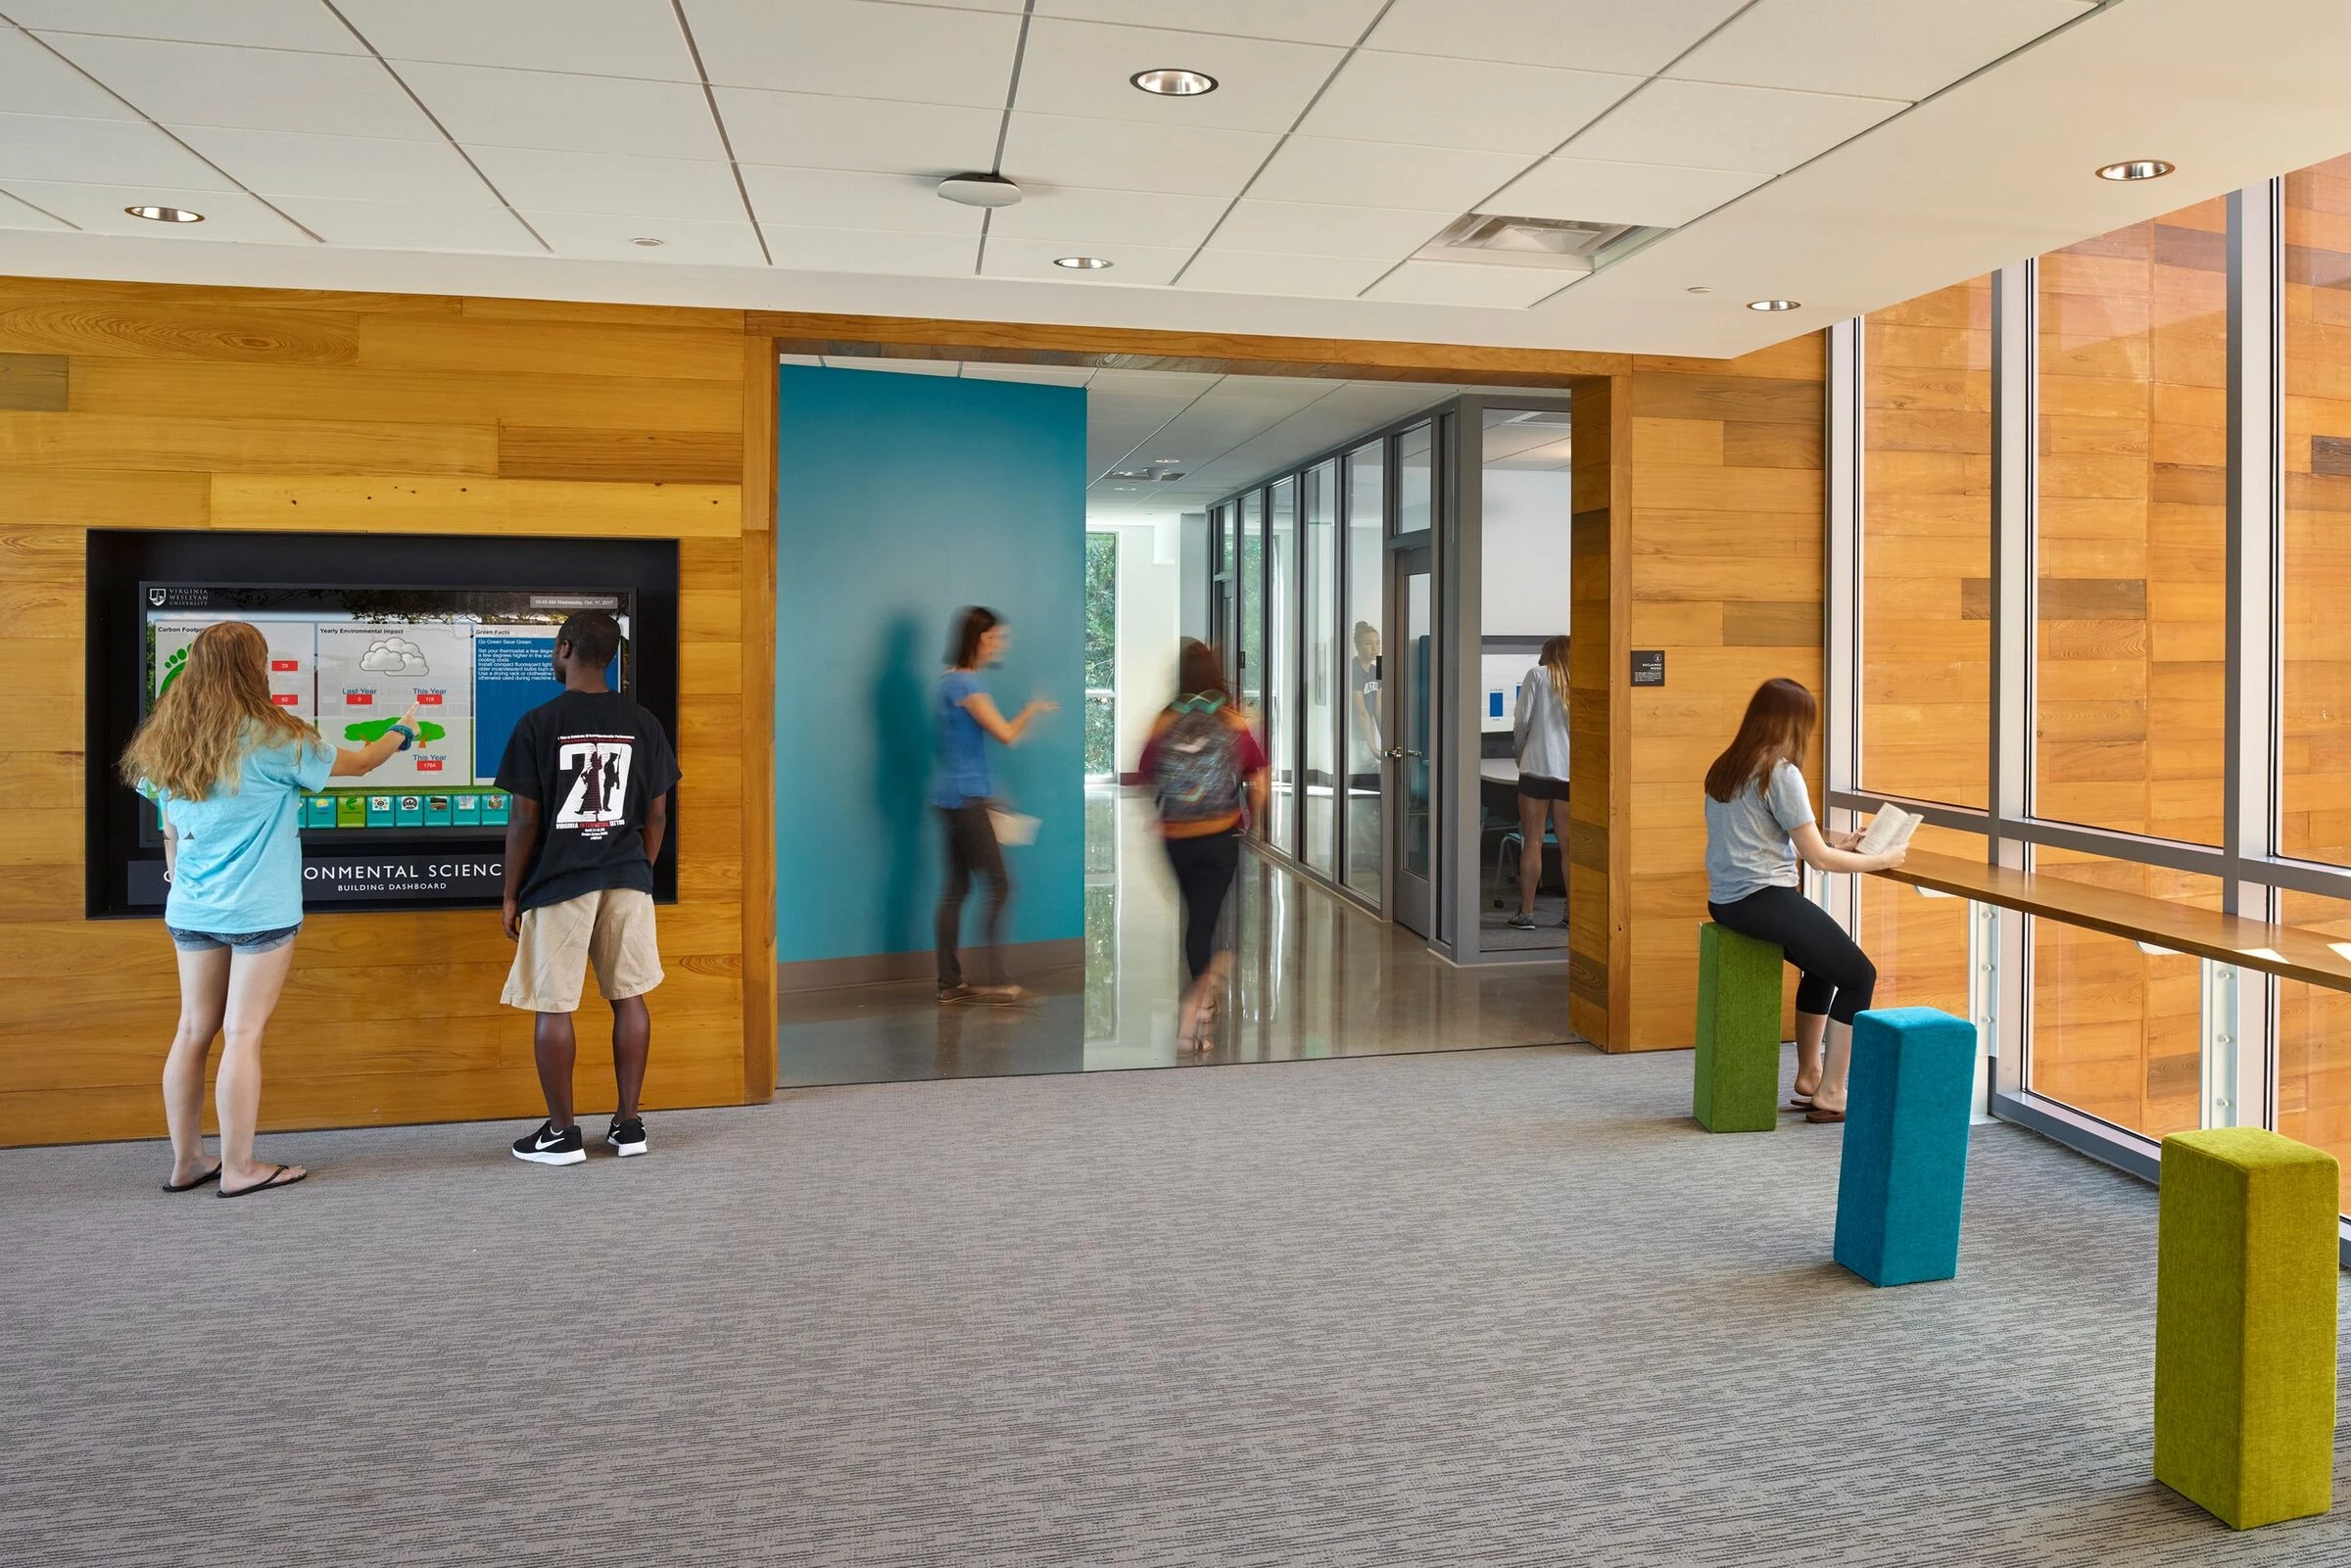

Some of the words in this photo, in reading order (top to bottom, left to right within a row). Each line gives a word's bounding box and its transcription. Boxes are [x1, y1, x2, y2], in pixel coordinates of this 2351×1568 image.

[304, 865, 419, 880] ONMENTAL
[429, 864, 502, 879] SCIENC
[389, 883, 446, 891] DASHBOARD
